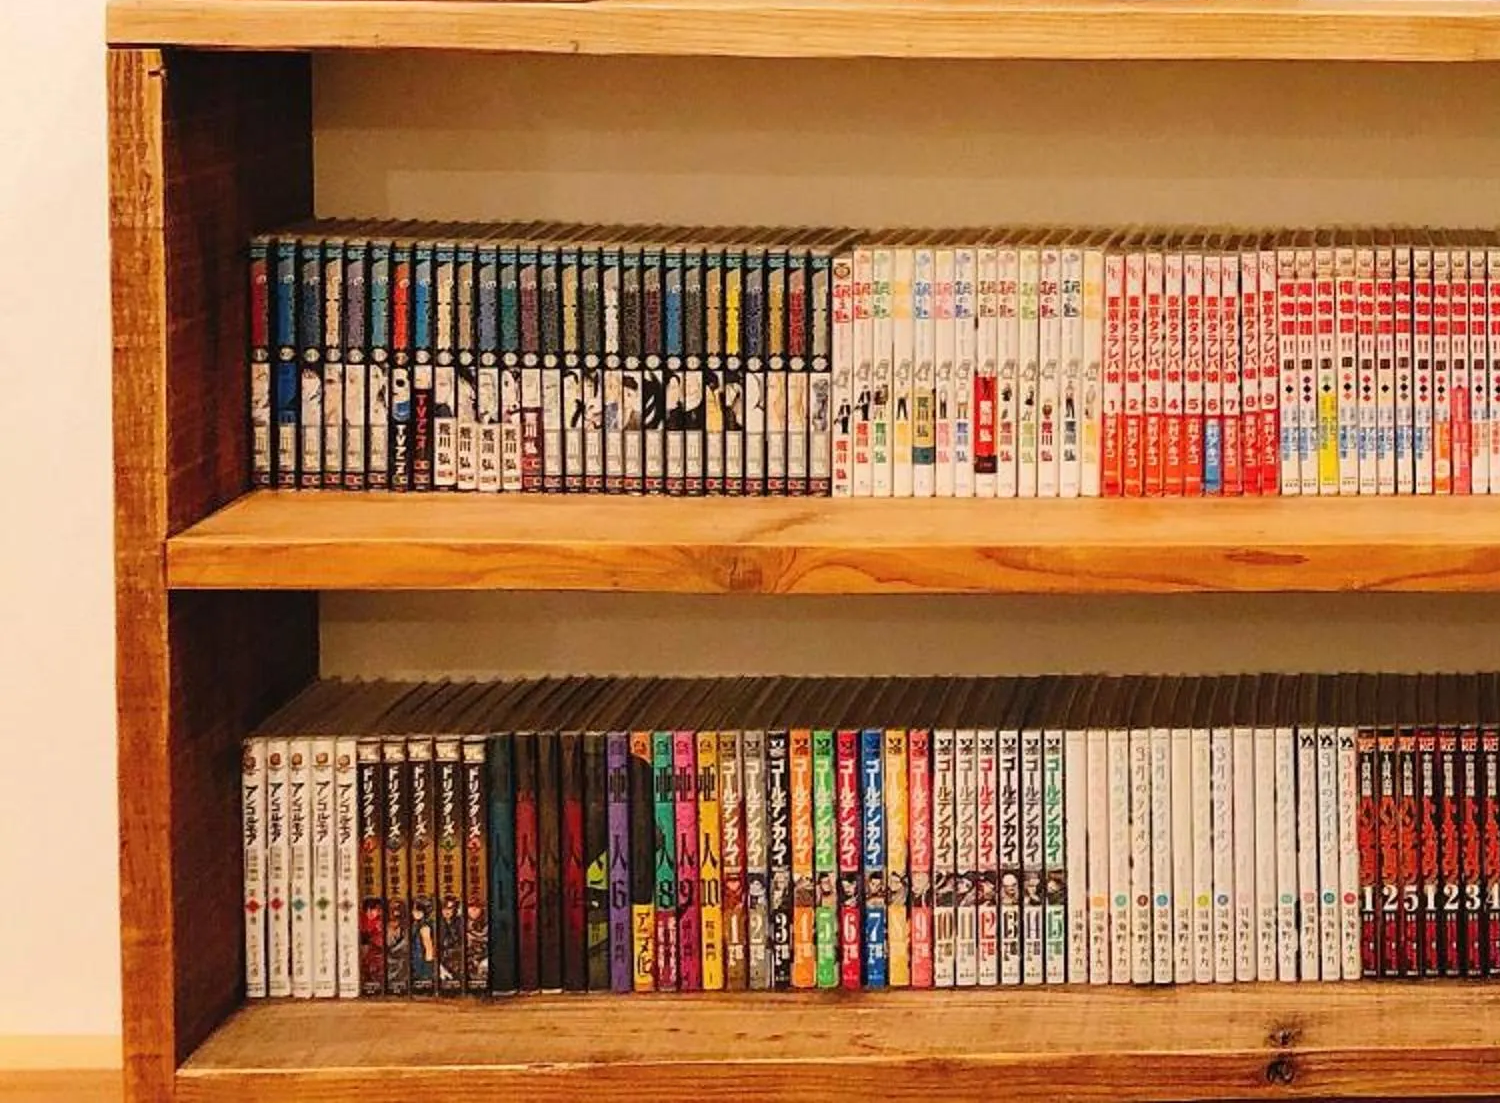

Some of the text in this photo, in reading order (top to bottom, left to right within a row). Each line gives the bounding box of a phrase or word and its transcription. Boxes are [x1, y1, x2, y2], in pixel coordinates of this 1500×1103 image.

[1130, 399, 1140, 411] 2
[1150, 397, 1159, 409] 3
[1168, 399, 1179, 411] 4
[1188, 399, 1198, 411] 5
[1207, 399, 1217, 411] 6
[1226, 399, 1236, 411] 7
[1246, 396, 1256, 408] 8
[1265, 393, 1275, 405] 9
[1109, 400, 1117, 411] 1
[1363, 885, 1374, 911] 1
[1383, 885, 1398, 910] 2
[1404, 885, 1419, 910] 5
[1424, 885, 1438, 911] 1
[1443, 885, 1459, 910] 2
[1465, 885, 1481, 910] 3
